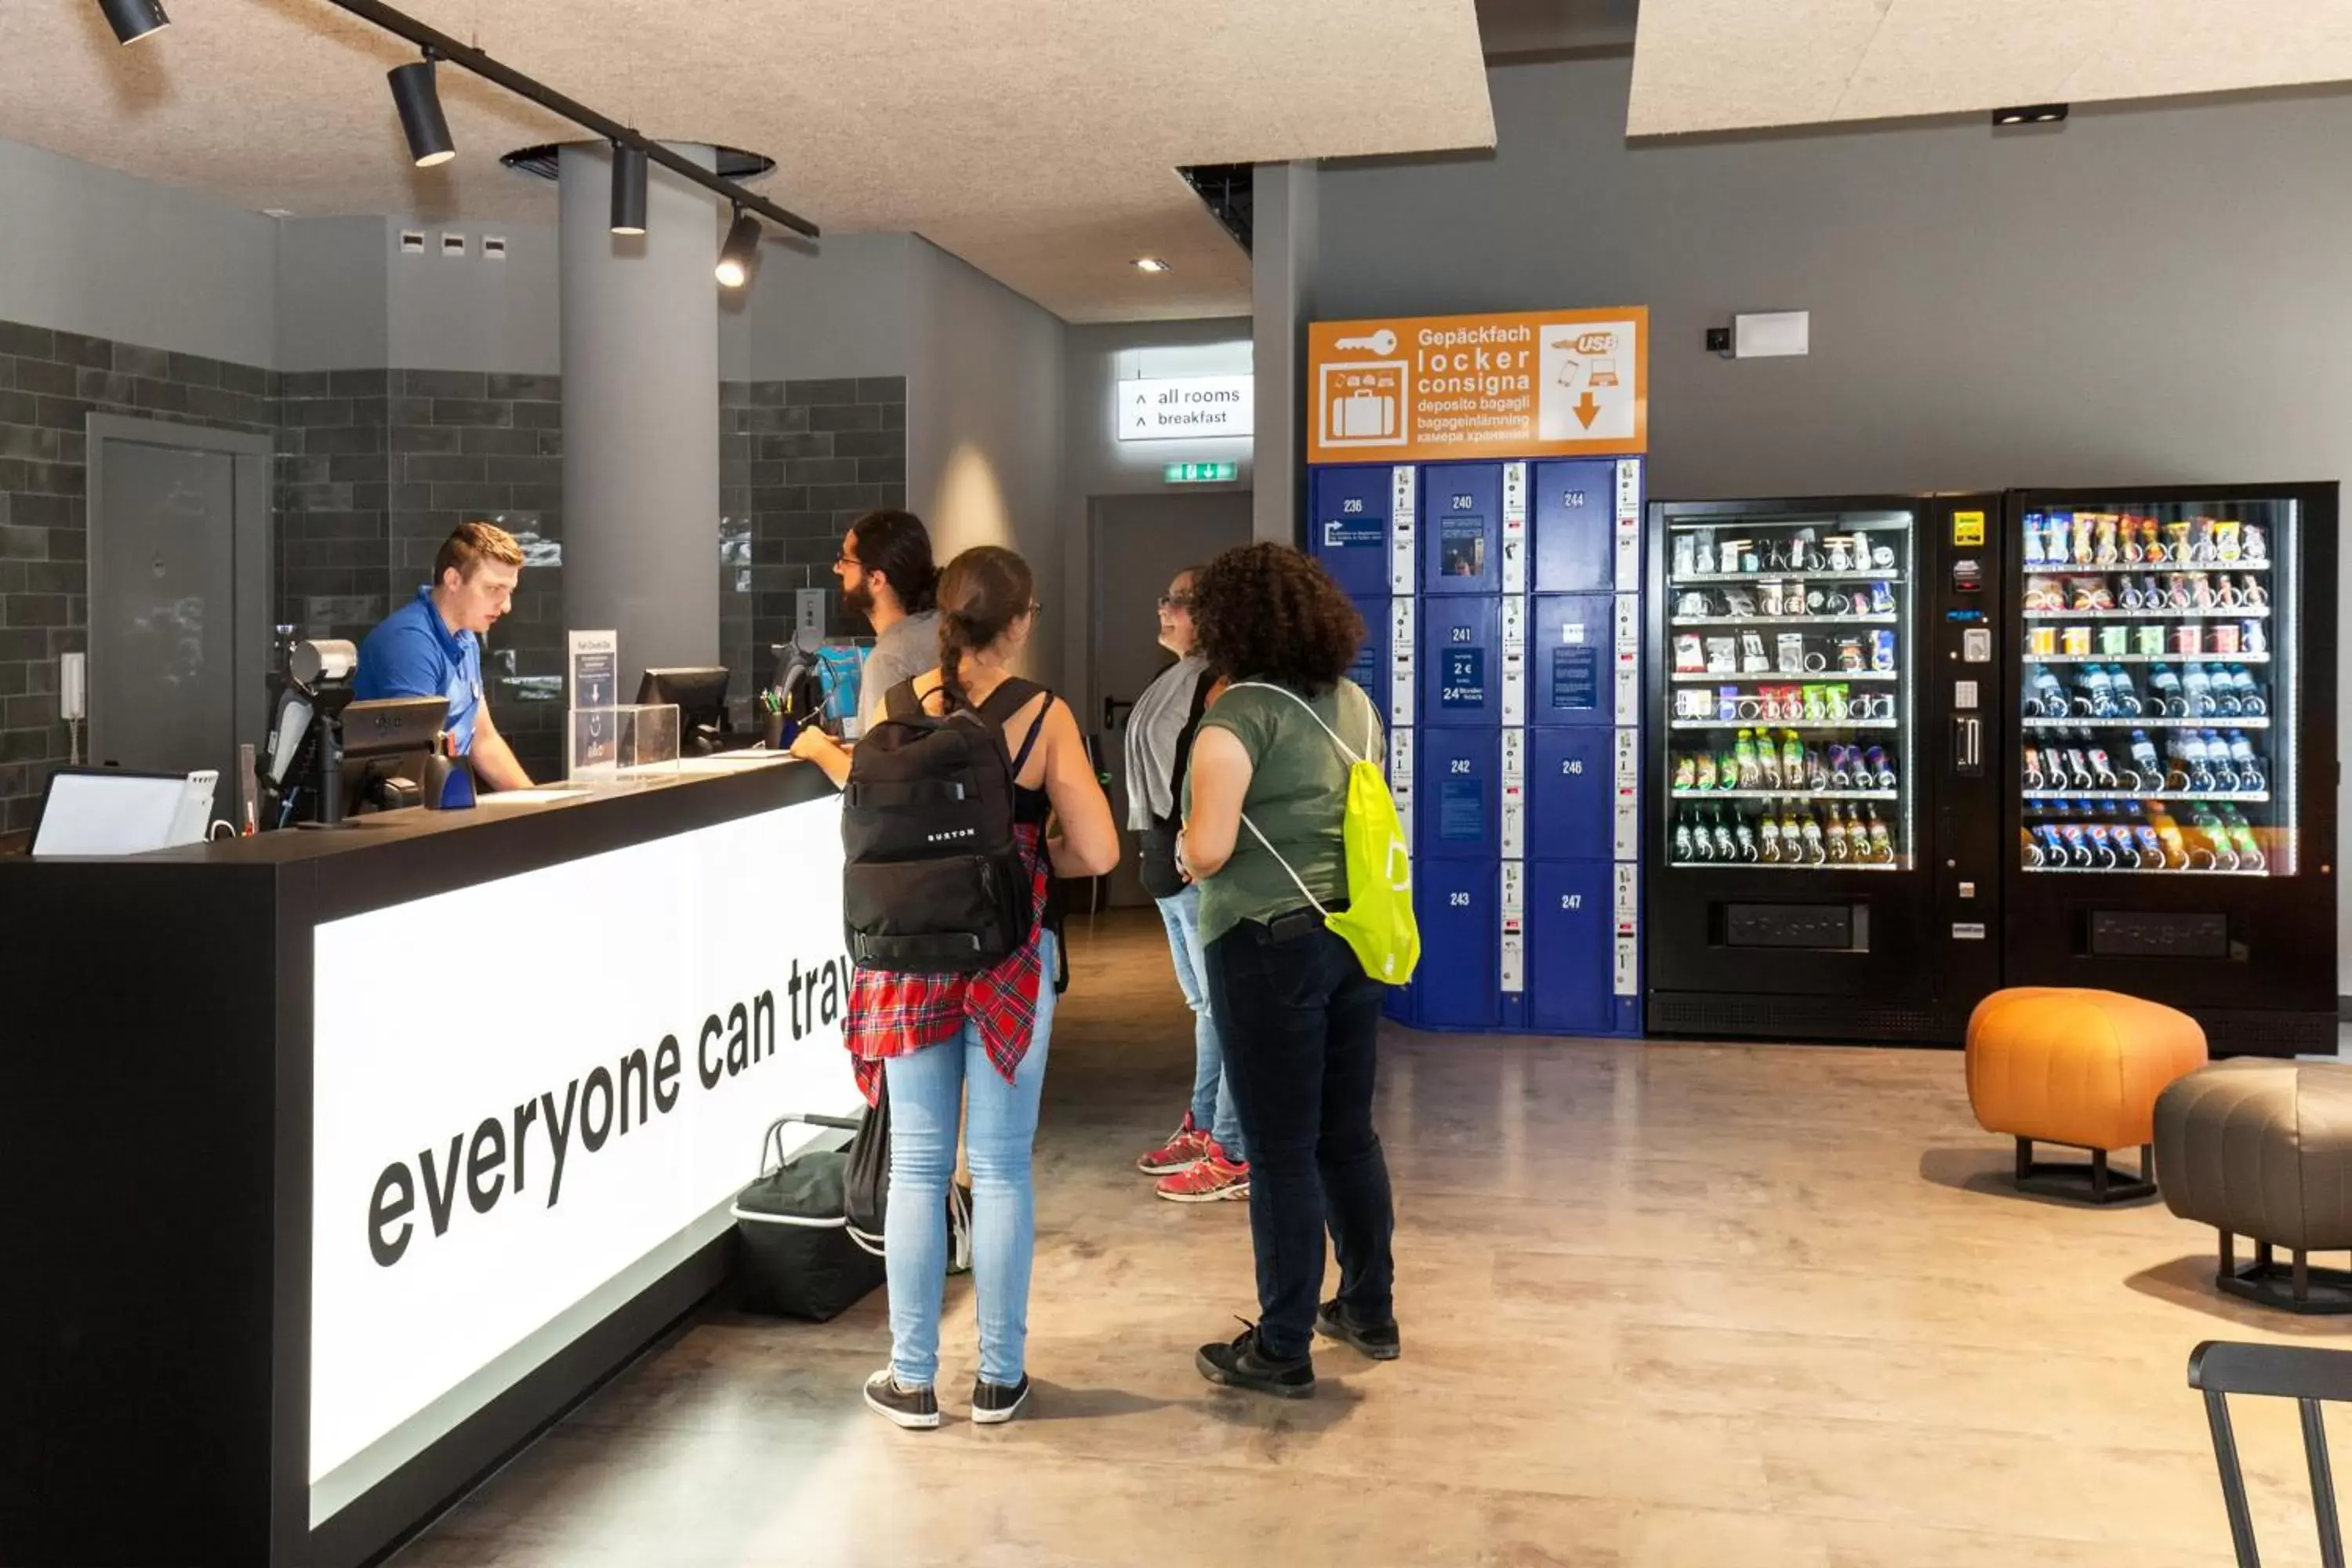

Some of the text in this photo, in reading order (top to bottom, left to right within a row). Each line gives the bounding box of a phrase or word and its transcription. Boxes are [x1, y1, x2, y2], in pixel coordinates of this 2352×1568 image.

[1418, 325, 1530, 349] Gepäckfach
[1418, 347, 1530, 373] locker
[1418, 372, 1530, 395] consigna
[1158, 389, 1240, 405] all rooms
[1418, 395, 1530, 414] deposito bagagli
[1158, 411, 1227, 425] breakfast
[1453, 495, 1472, 509] 240
[1564, 492, 1583, 506] 244
[1453, 628, 1470, 641] 241
[1454, 662, 1472, 675] 2 €
[1443, 688, 1459, 700] 24
[1451, 760, 1470, 773] 242
[927, 828, 975, 842] BURTON
[1450, 892, 1469, 906] 243
[1562, 895, 1581, 909] 247
[368, 1033, 681, 1268] everyone
[699, 989, 775, 1091] can
